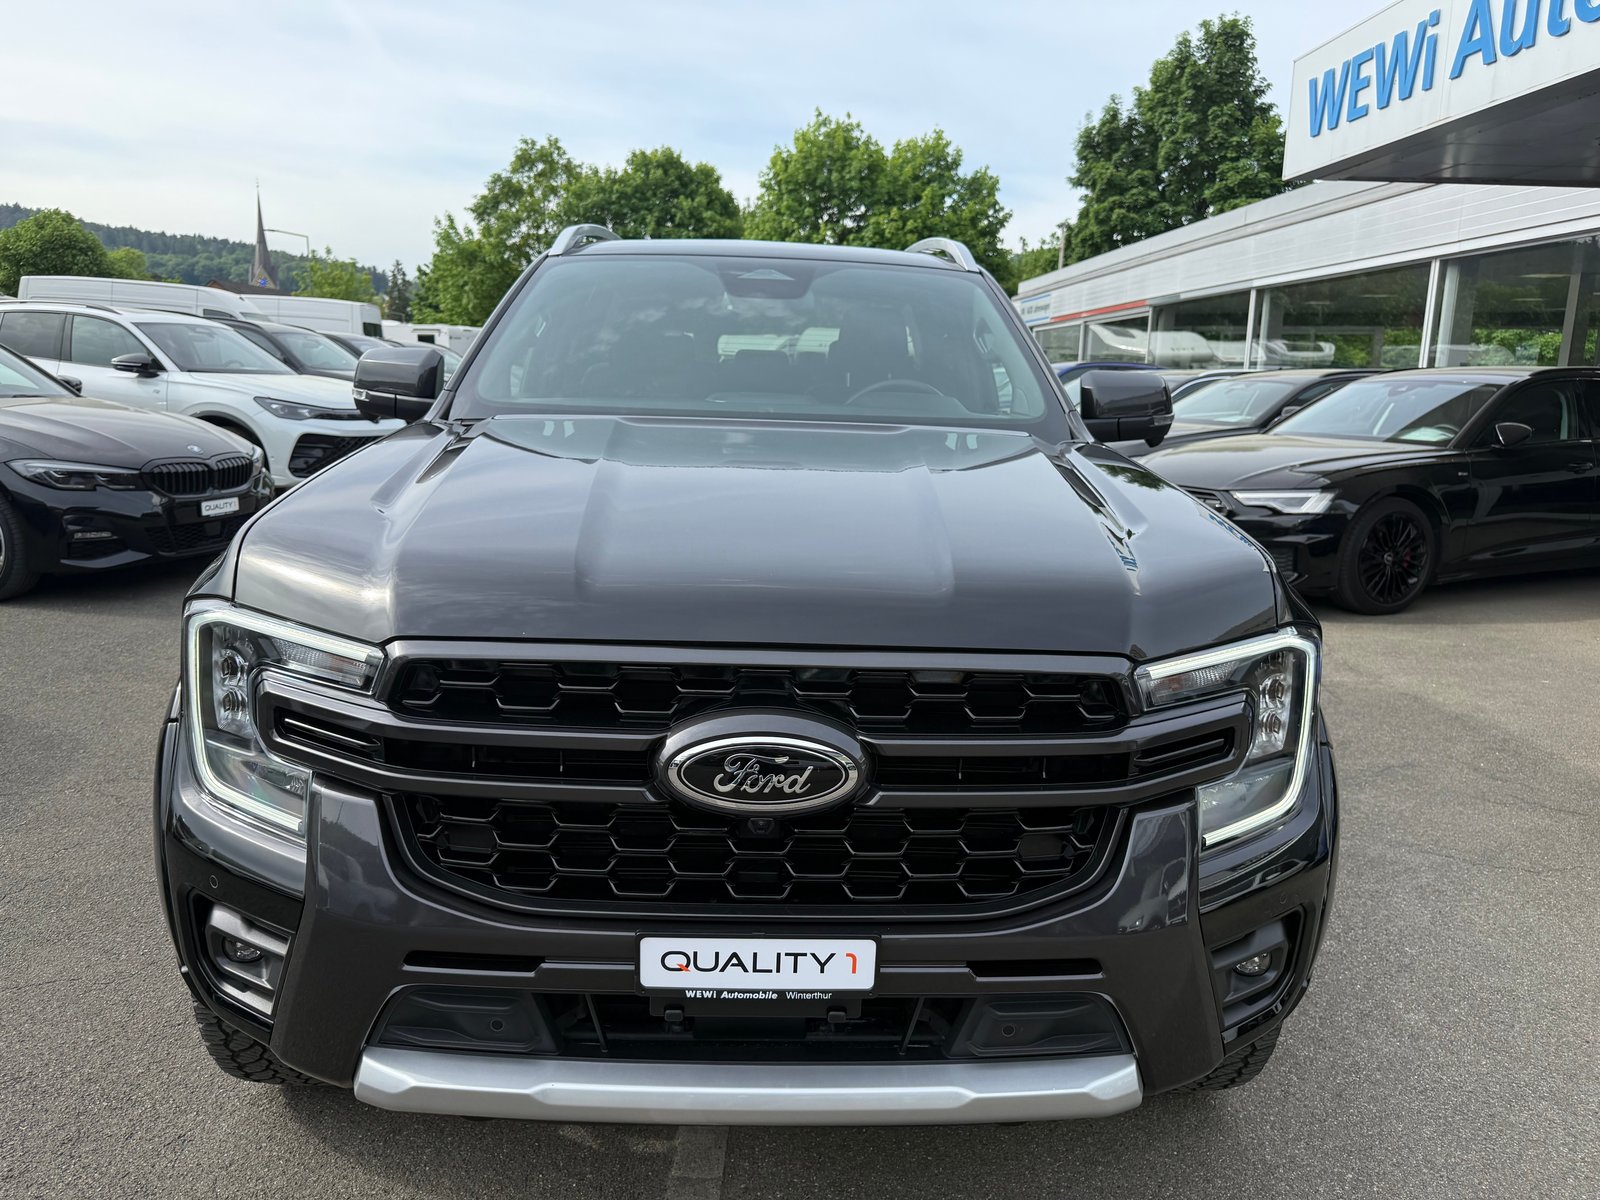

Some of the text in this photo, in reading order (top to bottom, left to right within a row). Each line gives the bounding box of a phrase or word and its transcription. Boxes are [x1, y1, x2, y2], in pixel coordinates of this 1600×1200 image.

[1309, 0, 1600, 138] WEWi Au
[713, 753, 814, 794] Ford
[660, 950, 858, 975] QUALITY 1
[720, 989, 778, 999] Automobile
[785, 990, 833, 1000] Winterthur
